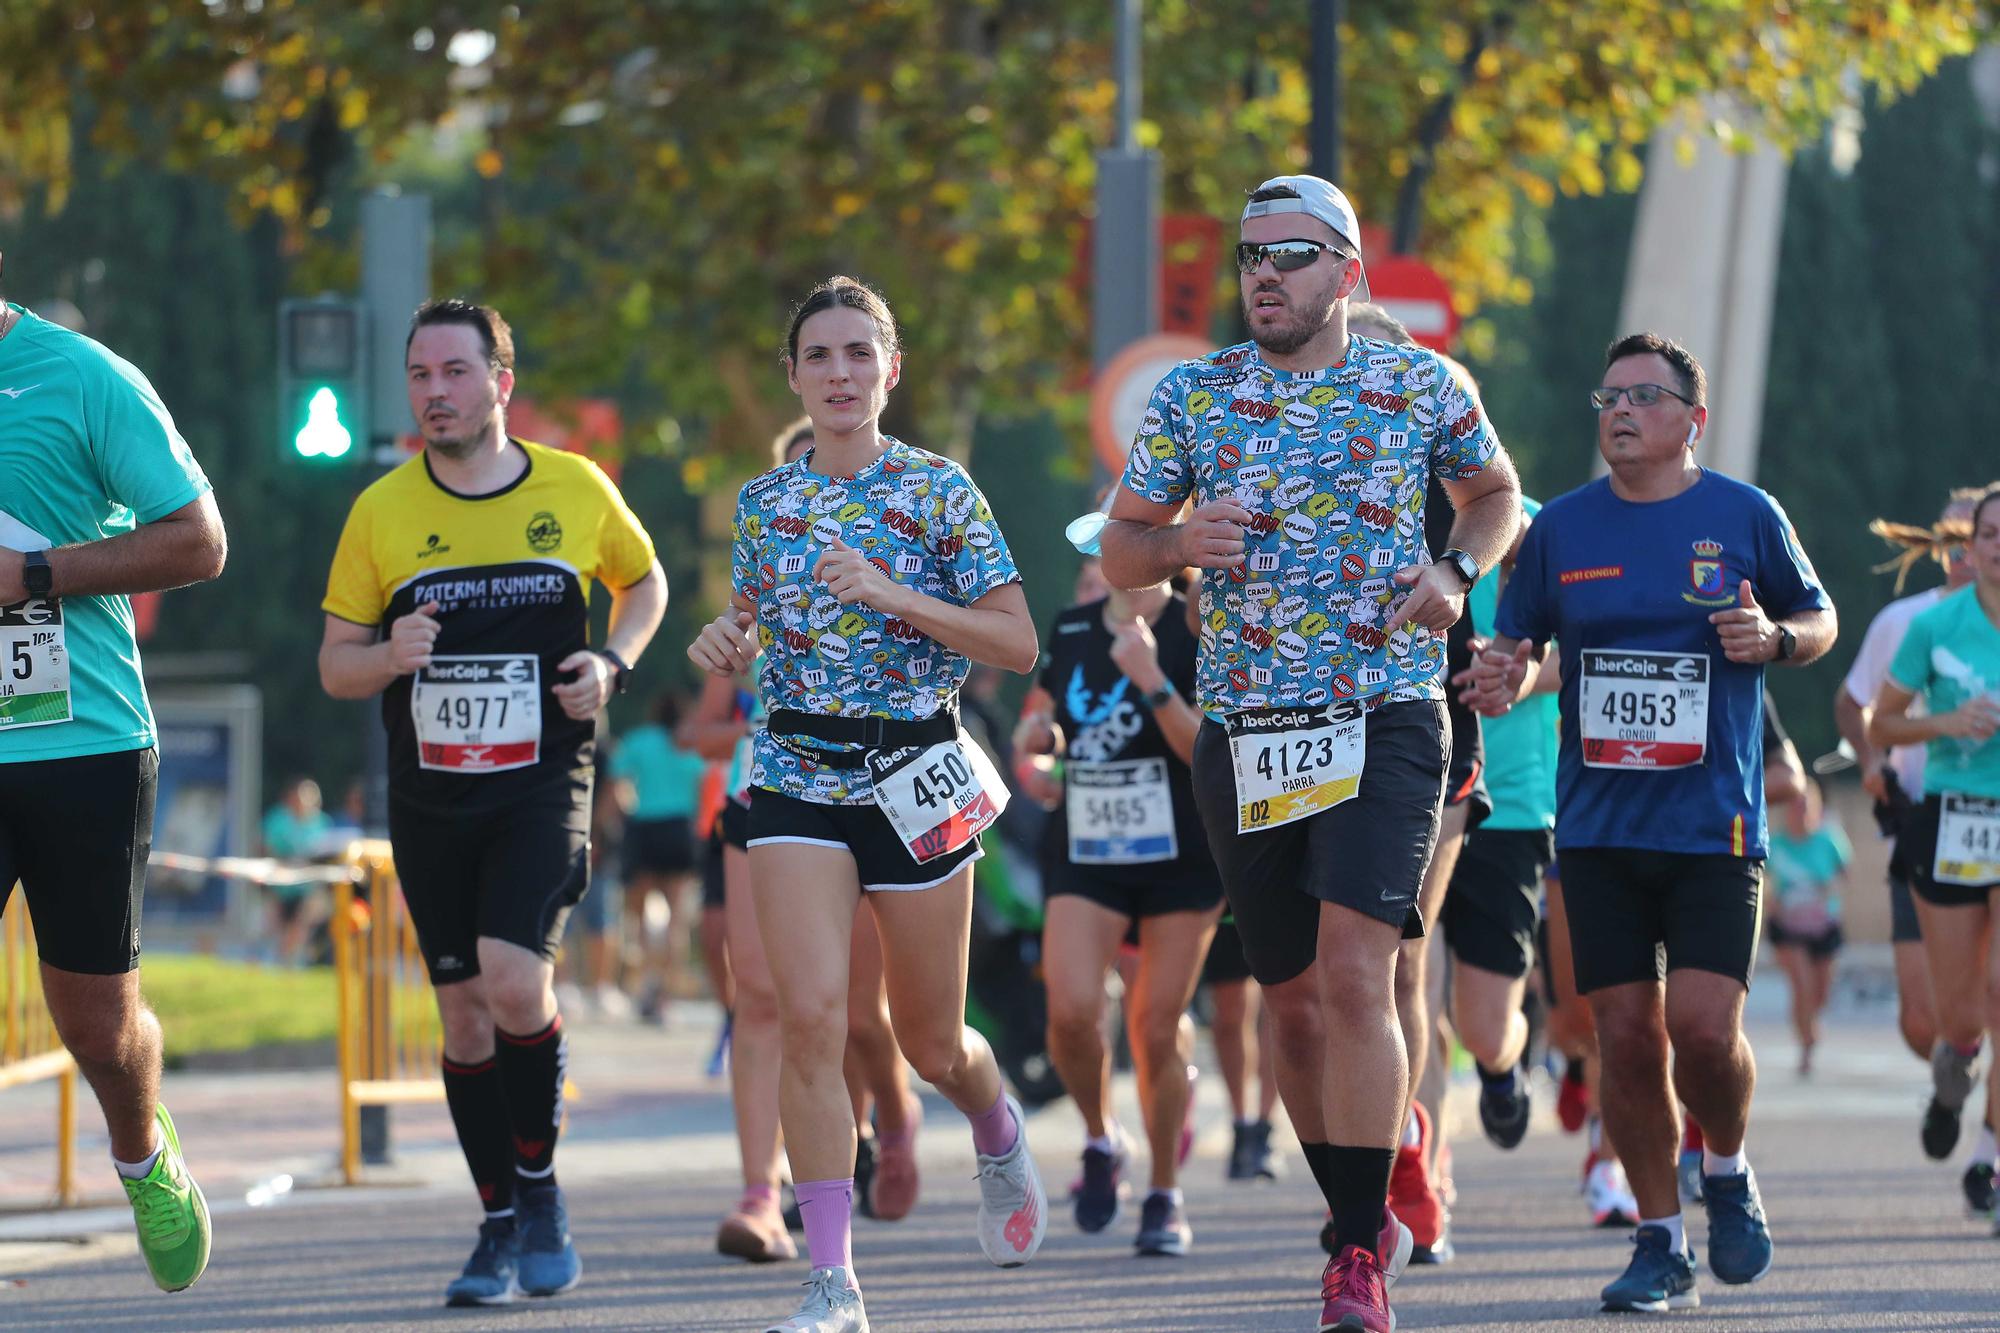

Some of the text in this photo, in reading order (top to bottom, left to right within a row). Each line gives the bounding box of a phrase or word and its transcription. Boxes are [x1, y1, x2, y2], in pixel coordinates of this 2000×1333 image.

[1371, 357, 1398, 366] CRASH
[1199, 377, 1233, 387] luanvi
[1441, 377, 1454, 401] CRASH
[1359, 390, 1409, 412] BOOM
[1229, 399, 1280, 420] BOOM
[1330, 431, 1344, 440] HA!
[1390, 435, 1403, 446] !!!
[1256, 440, 1272, 452] !!!
[1350, 440, 1374, 456] BAM!!!
[1218, 449, 1239, 465] BAM!!!
[1240, 470, 1267, 480] CRASH
[1374, 465, 1398, 473] CRASH
[1285, 482, 1310, 499] POOF
[1356, 502, 1397, 528] BOOM
[881, 508, 924, 537] BOOM
[786, 558, 800, 571] !!!
[904, 558, 918, 571] !!!
[1259, 557, 1273, 569] !!!
[1378, 552, 1390, 564] !!!
[1342, 558, 1363, 576] BAM!!!
[1584, 567, 1620, 580] CONGUI
[961, 572, 974, 590] !!!
[415, 574, 566, 603] PATERNA RUNNERS
[1248, 588, 1270, 596] CRASH
[1362, 584, 1385, 593] CRASH
[778, 590, 799, 601] CRASH
[1345, 623, 1387, 648] BOOM
[0, 641, 32, 679] 5
[1420, 662, 1432, 670] HA!
[915, 661, 927, 674] !!!
[808, 672, 822, 684] !!!
[1256, 671, 1267, 683] !!!
[1367, 672, 1380, 682] !!!
[0, 685, 15, 696] IA
[1333, 677, 1353, 694] BAM!!!
[437, 697, 509, 729] 4977
[1602, 691, 1676, 726] 4953
[1619, 728, 1656, 741] CONGUI
[1257, 737, 1333, 780] 4123
[815, 780, 839, 788] CRASH
[1282, 775, 1315, 792] PARRA
[954, 789, 976, 810] CRIS
[1251, 800, 1270, 822] 02
[920, 827, 948, 853] 02
